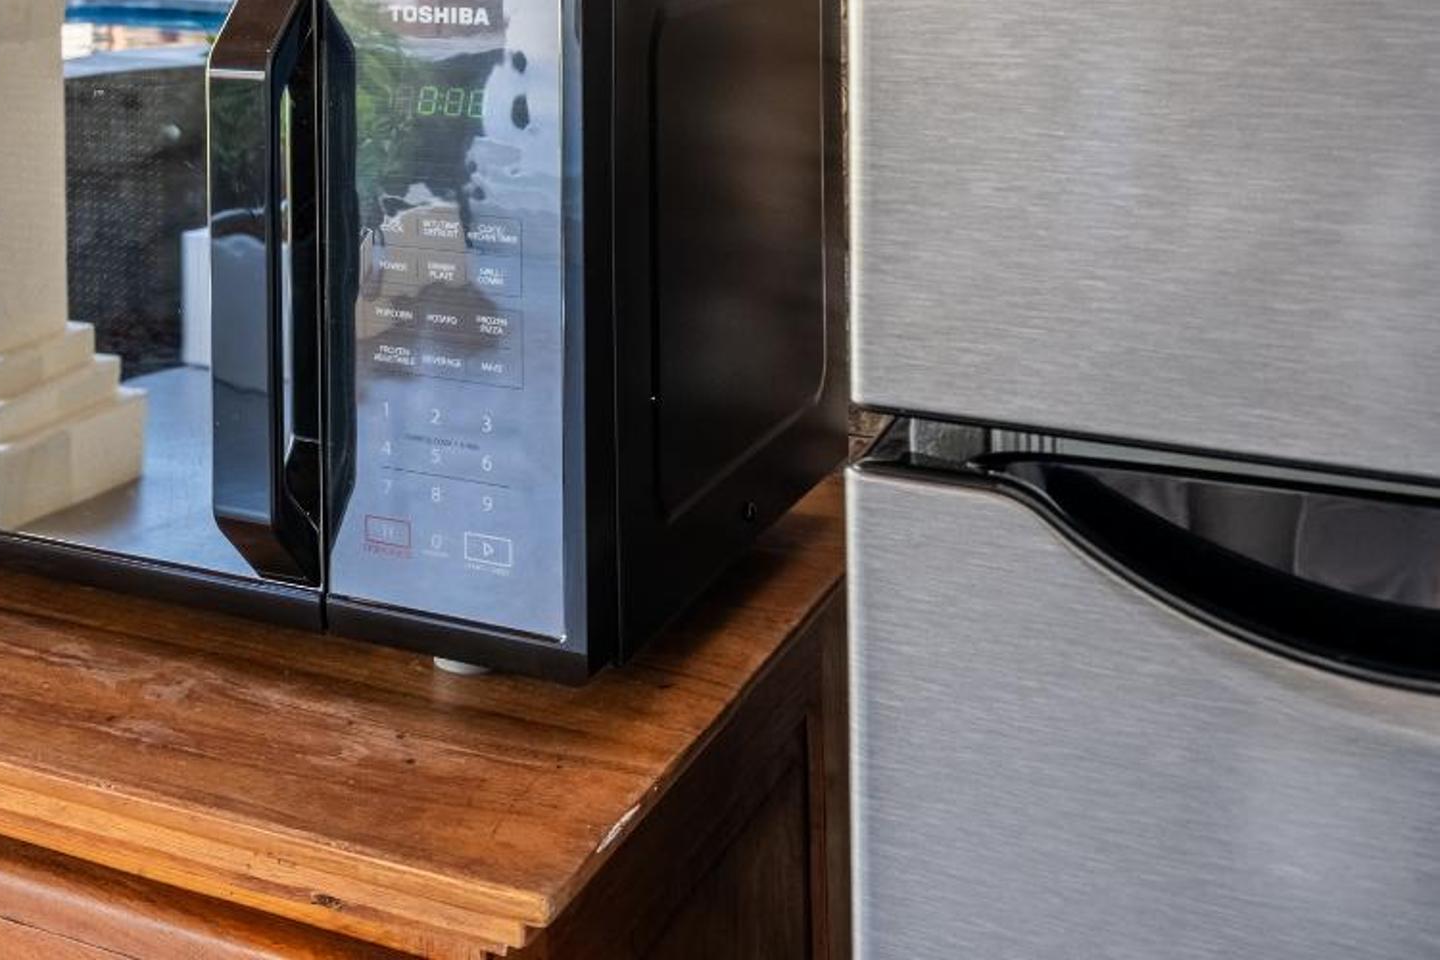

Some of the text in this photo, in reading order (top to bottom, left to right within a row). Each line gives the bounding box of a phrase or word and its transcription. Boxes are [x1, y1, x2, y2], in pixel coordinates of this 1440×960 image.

[389, 5, 490, 26] TOSHIBA
[383, 401, 389, 417] 1
[430, 408, 441, 425] 2
[481, 414, 493, 433] 3
[382, 441, 392, 457] 4
[430, 448, 441, 464] 5
[481, 454, 493, 472] 6
[431, 486, 441, 503] 8
[482, 496, 494, 513] 9
[431, 533, 442, 549] 0
